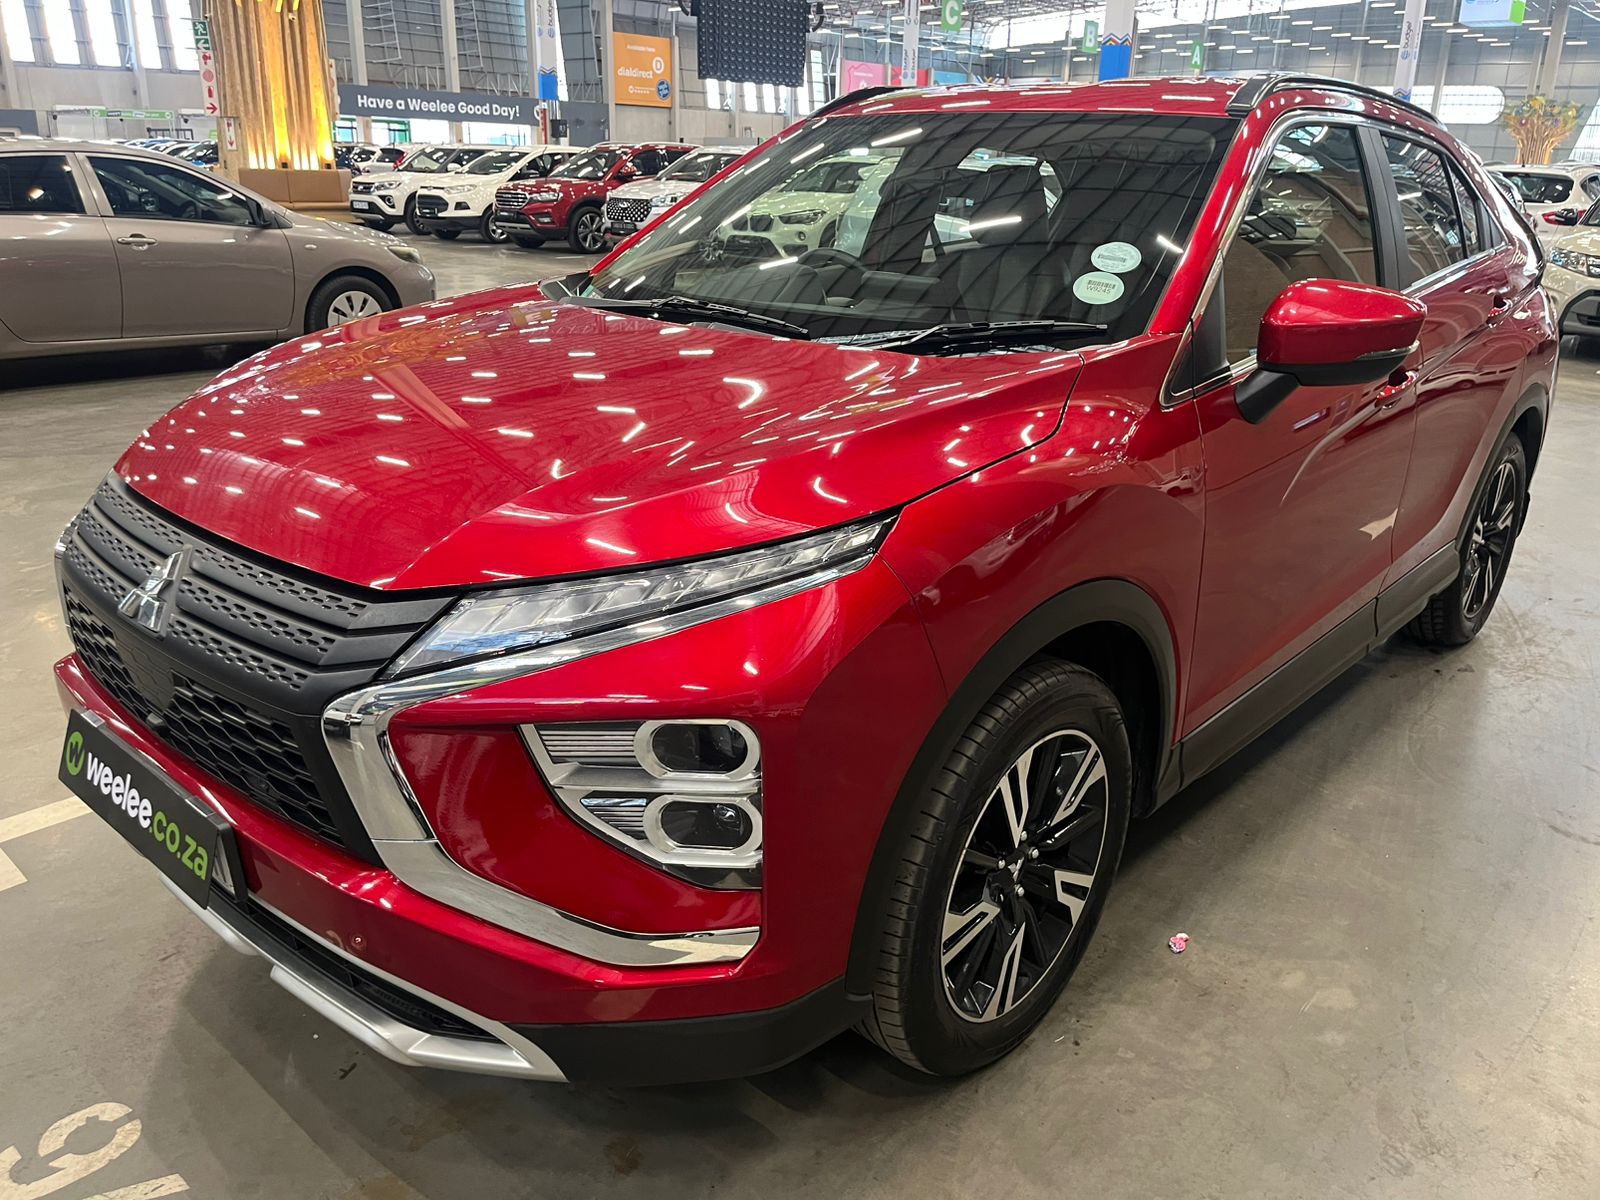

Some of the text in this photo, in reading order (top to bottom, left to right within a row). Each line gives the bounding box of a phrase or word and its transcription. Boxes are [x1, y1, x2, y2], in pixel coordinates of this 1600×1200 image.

[945, 1, 959, 25] C
[1085, 25, 1095, 47] B
[1191, 44, 1200, 64] A
[357, 94, 520, 120] Have a Weelee Good Day!
[87, 752, 208, 880] weelee.co.za
[0, 1102, 190, 1200] 9
